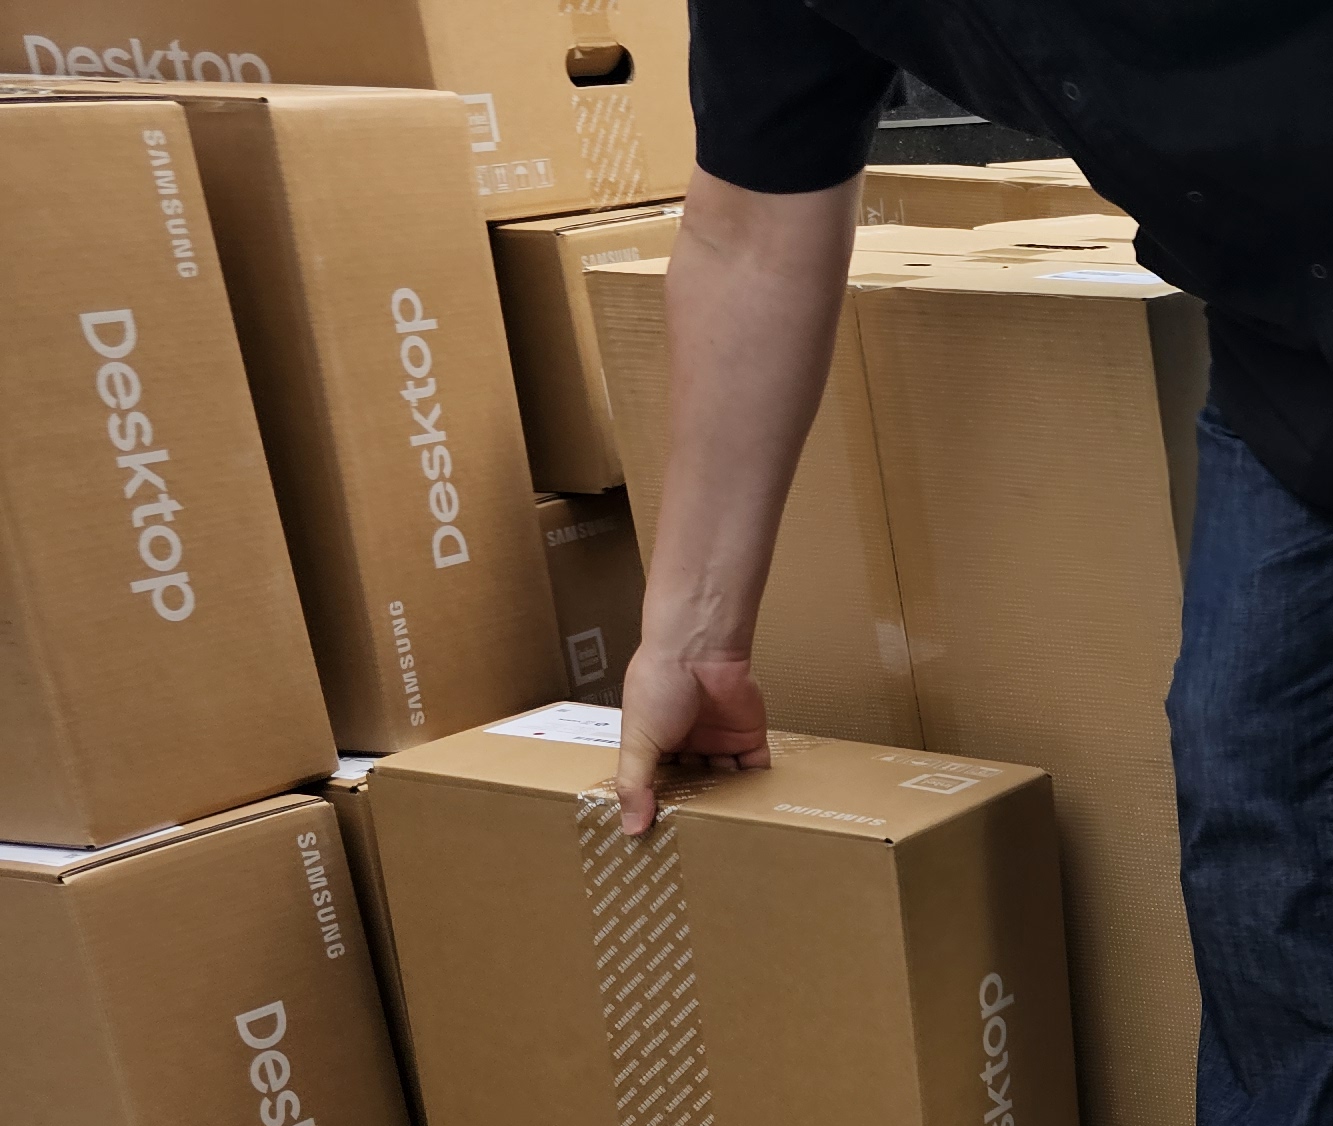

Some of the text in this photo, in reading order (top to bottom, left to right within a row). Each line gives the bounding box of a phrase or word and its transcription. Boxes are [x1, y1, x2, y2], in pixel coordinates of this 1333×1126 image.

[142, 129, 198, 278] SAMSUNG
[581, 247, 641, 267] SAMSUNG
[79, 308, 195, 622] Desktop
[390, 287, 470, 569] Desktop
[546, 518, 617, 547] SAMSU
[388, 600, 425, 727] SAMSUNG
[773, 803, 887, 826] SAMSUNG
[295, 831, 345, 960] SAMSUNG
